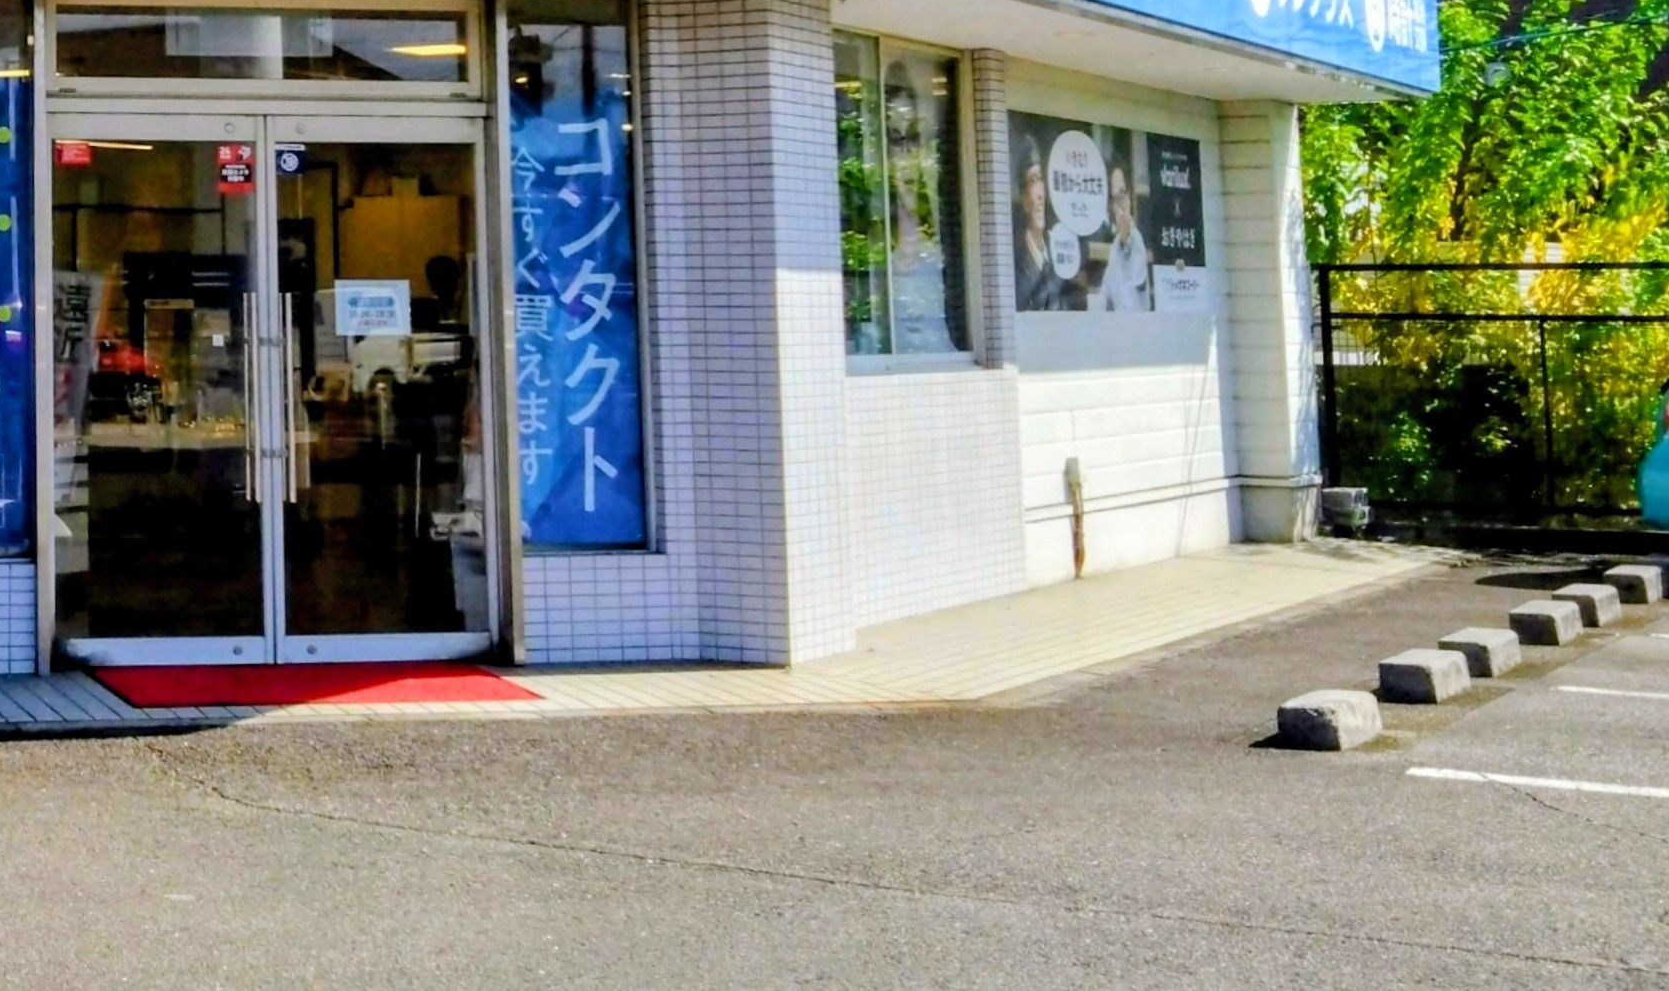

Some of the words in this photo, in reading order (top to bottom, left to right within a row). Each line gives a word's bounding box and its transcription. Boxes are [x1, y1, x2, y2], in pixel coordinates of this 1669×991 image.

[512, 144, 554, 486] 今すぐ買えます
[554, 117, 621, 512] コンタクト
